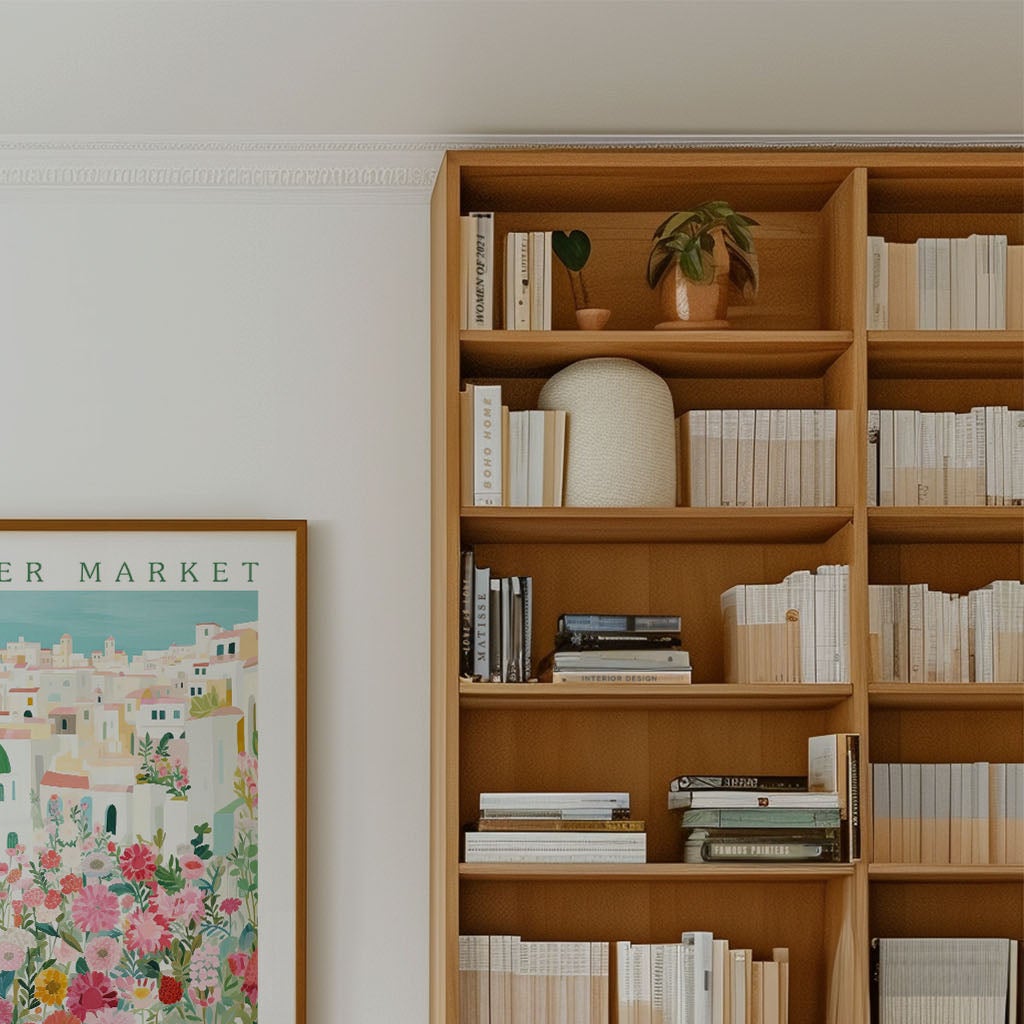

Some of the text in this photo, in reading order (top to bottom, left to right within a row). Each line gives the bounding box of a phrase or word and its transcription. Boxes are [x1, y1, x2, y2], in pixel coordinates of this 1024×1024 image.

[475, 258, 486, 276] OF
[475, 278, 485, 323] WOMEN
[483, 398, 492, 489] BOHO HOME
[79, 561, 260, 583] MARKET
[477, 592, 486, 662] MATISSE
[714, 845, 790, 855] FAMOUS PAINTERS
